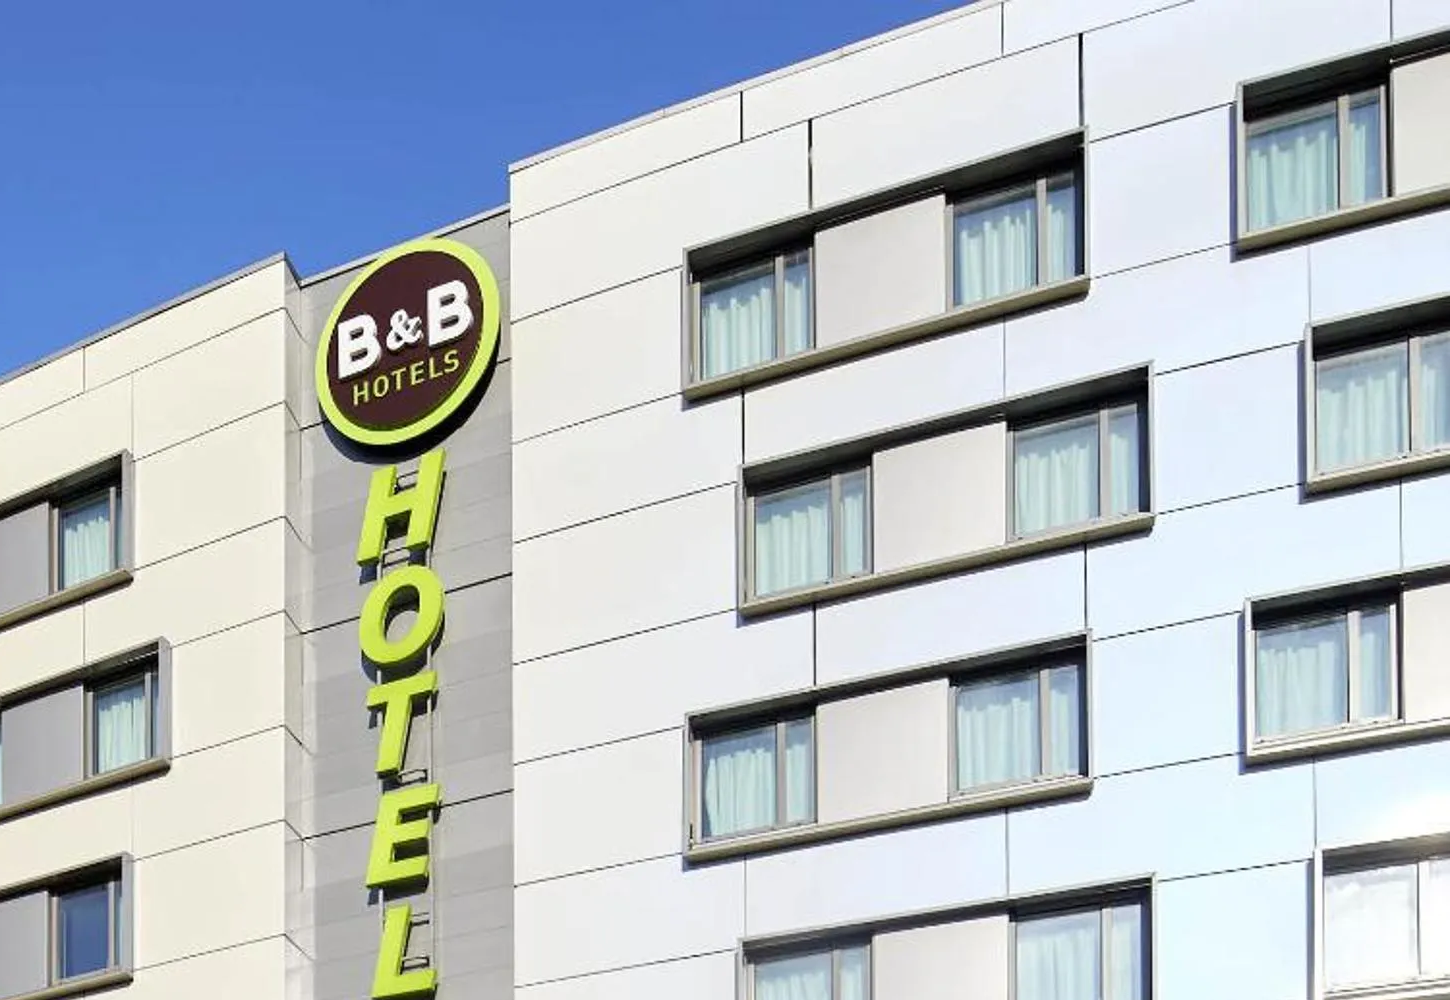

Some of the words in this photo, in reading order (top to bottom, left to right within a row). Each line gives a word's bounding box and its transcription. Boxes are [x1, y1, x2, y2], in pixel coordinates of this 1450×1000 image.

[337, 280, 474, 379] B&B
[353, 350, 460, 406] HOTELS
[356, 447, 446, 1000] HOTEL
